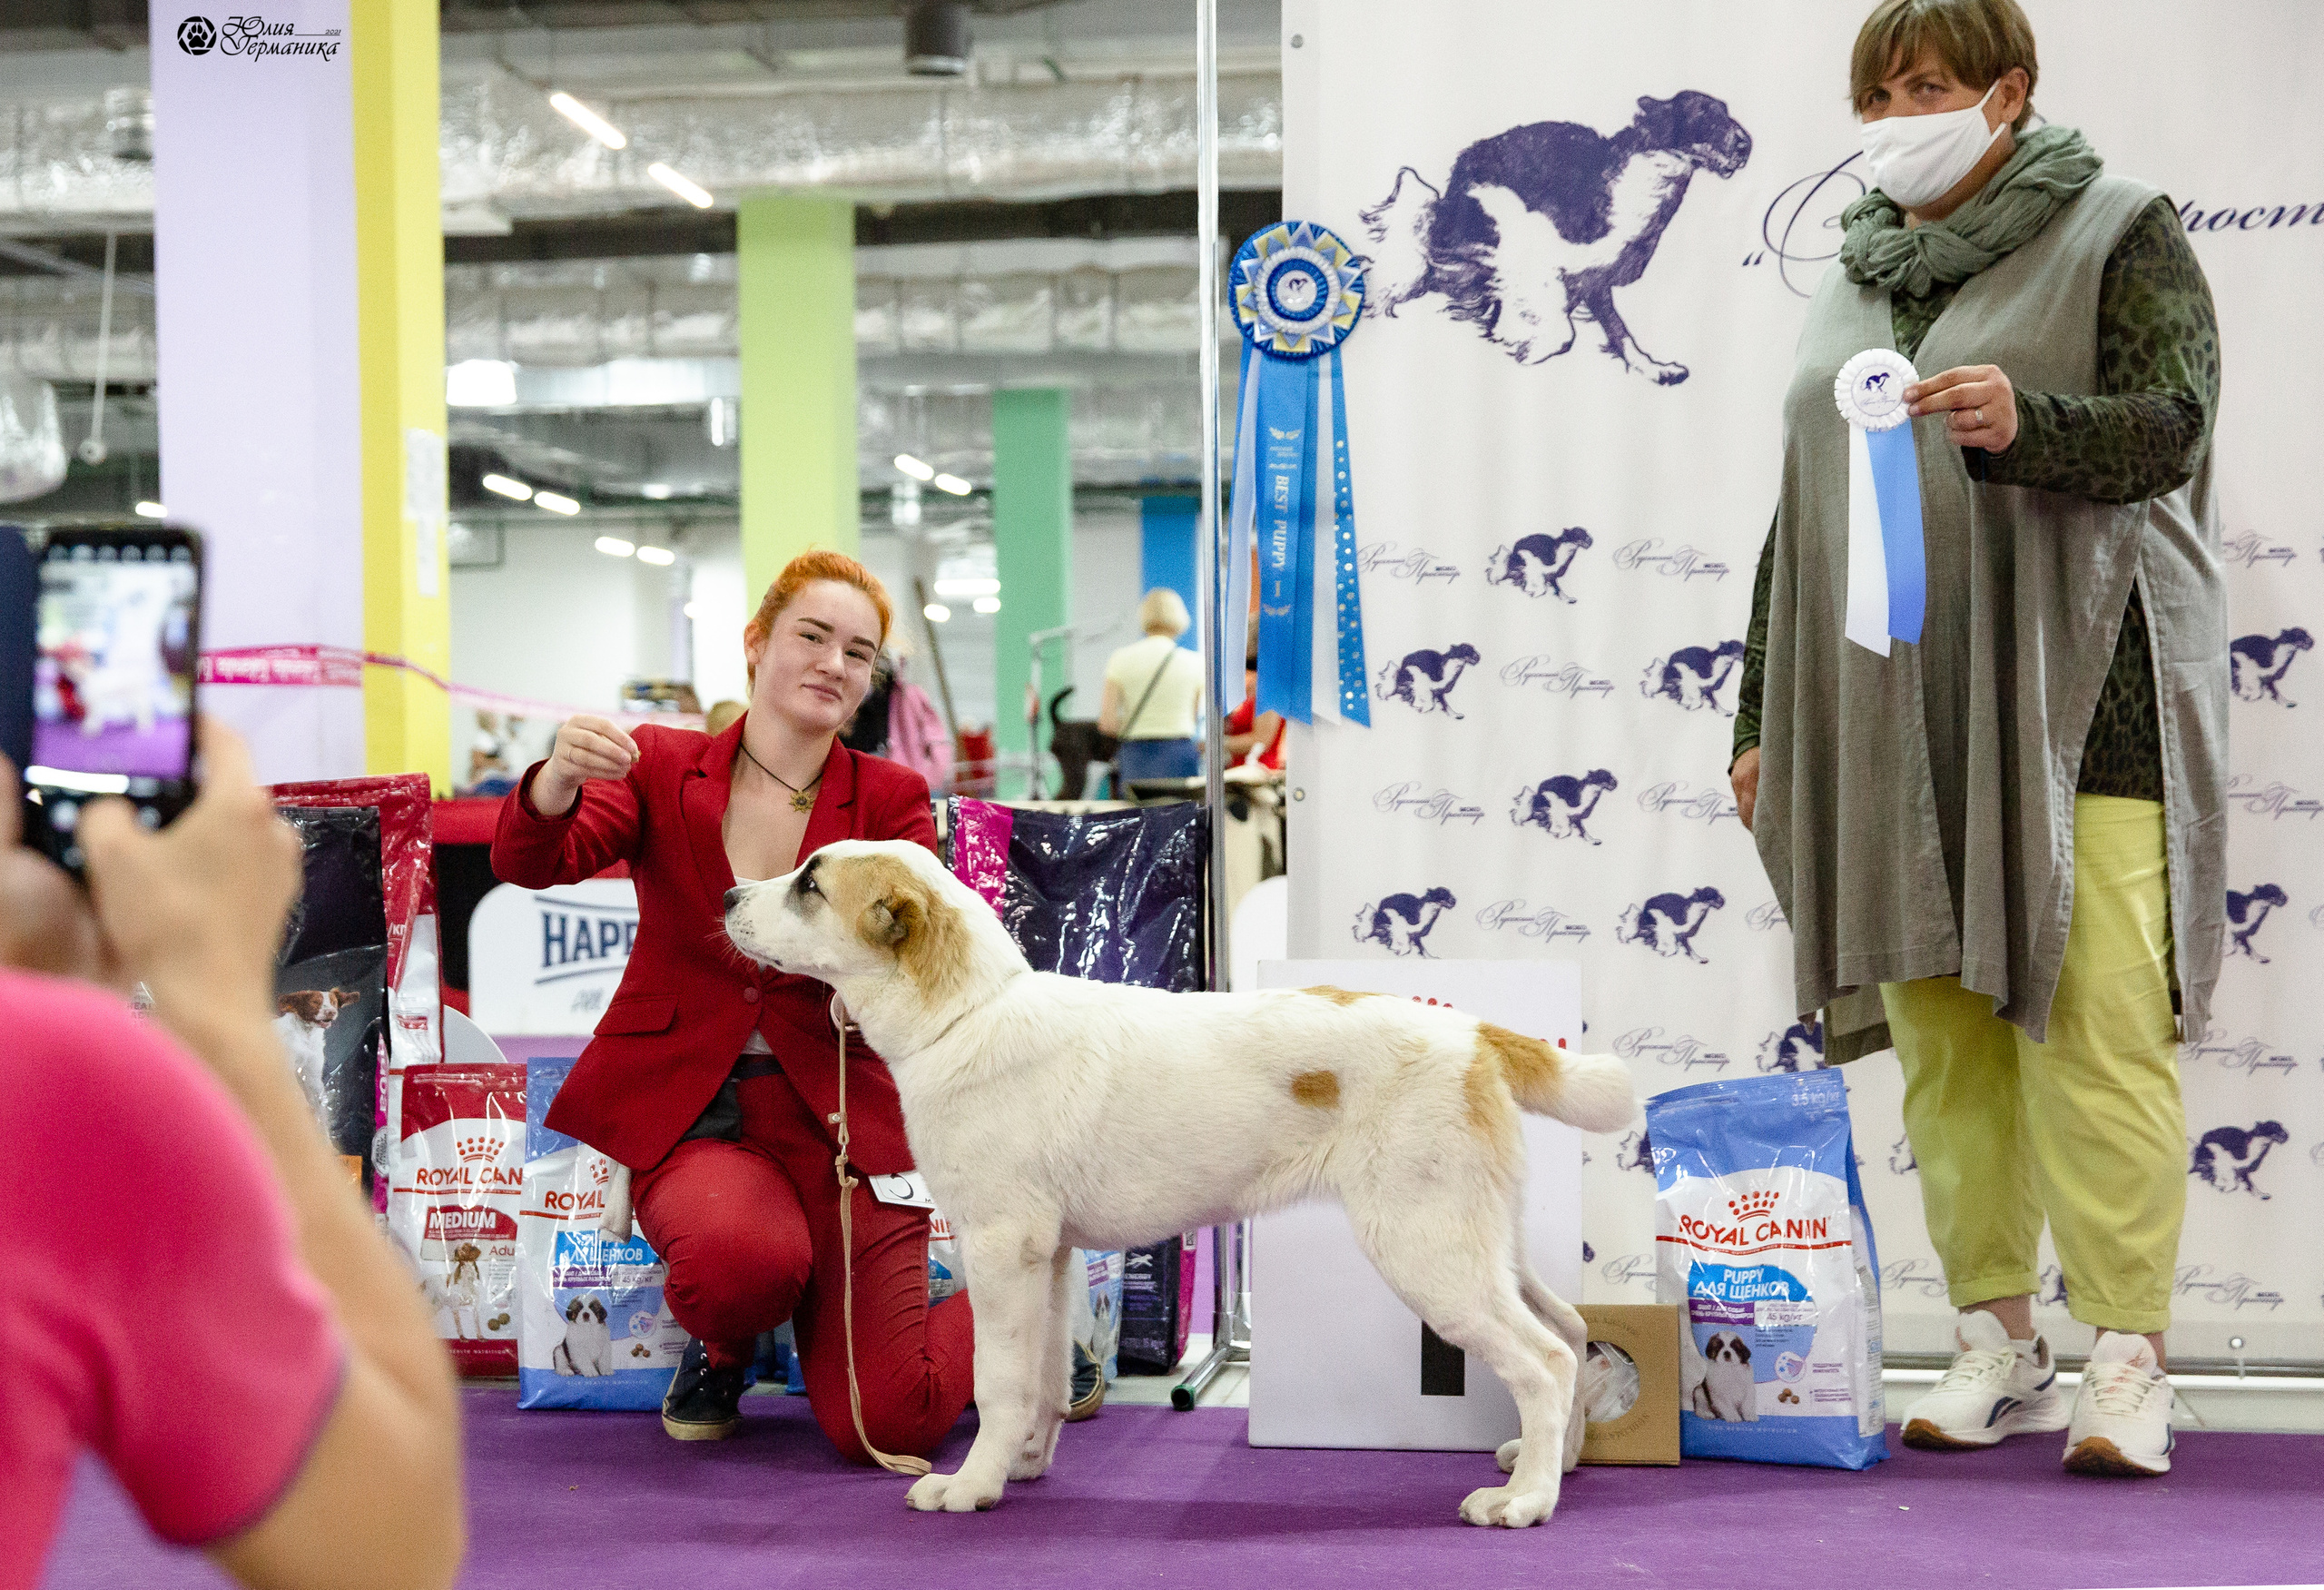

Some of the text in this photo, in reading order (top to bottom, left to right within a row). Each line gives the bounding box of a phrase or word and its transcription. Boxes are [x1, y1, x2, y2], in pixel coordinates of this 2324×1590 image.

[1275, 475, 1289, 513] BEST
[1272, 519, 1287, 570] PUPPY
[417, 1167, 523, 1186] ROYAL CAN
[545, 1190, 606, 1211] ROYAL
[428, 1211, 497, 1229] MEDIUM
[1679, 1214, 1827, 1246] ROYAL CANIN
[489, 1245, 515, 1257] Adu
[1723, 1267, 1763, 1284] PUPPY
[1692, 1279, 1790, 1299] ДЛЯ ЩЕНКОВ
